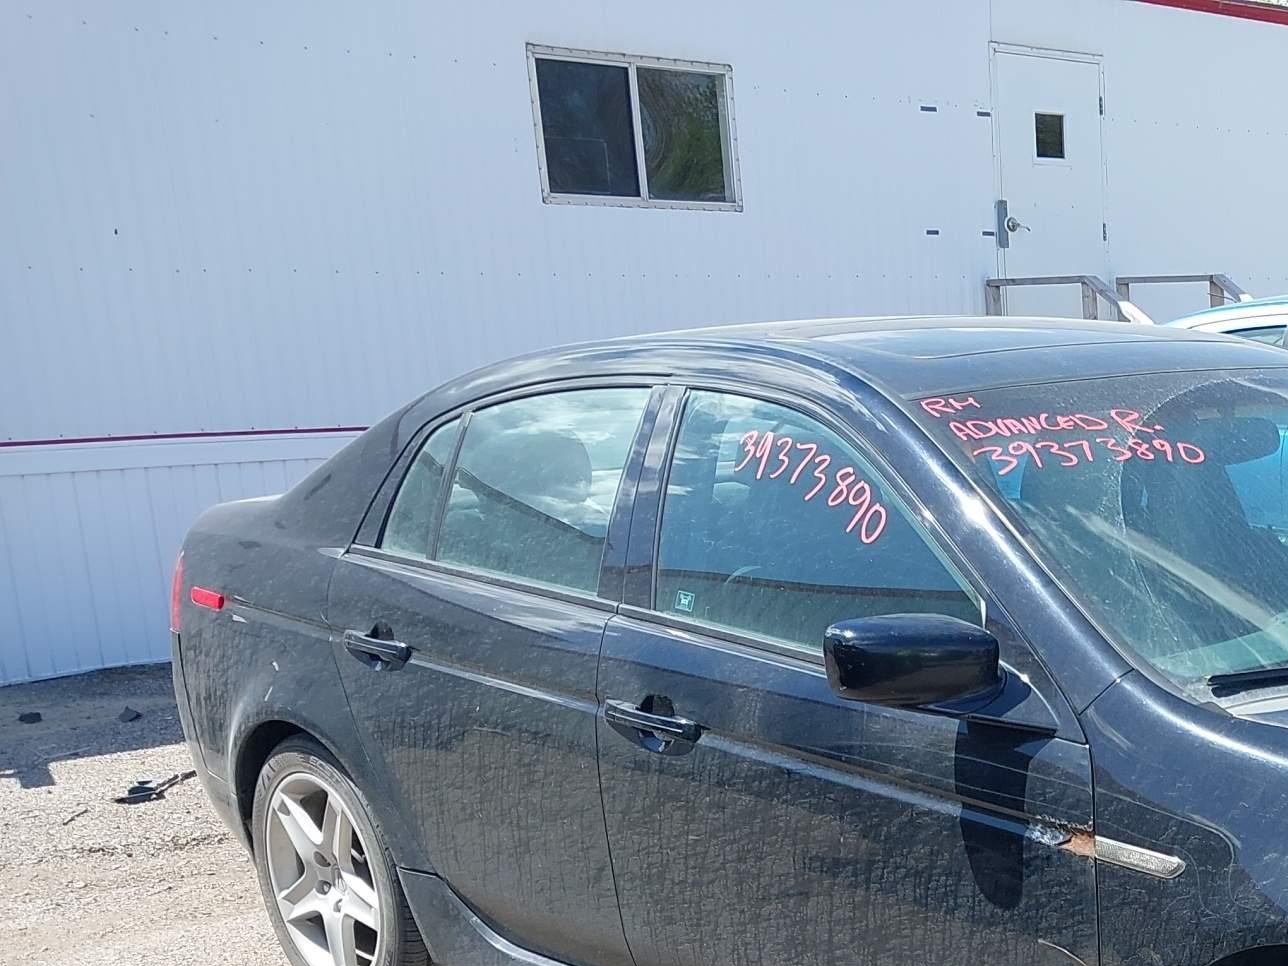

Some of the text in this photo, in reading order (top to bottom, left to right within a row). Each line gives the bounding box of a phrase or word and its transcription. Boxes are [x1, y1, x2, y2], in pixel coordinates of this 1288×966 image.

[948, 412, 1108, 442] ADVANCED
[972, 438, 1206, 476] 39373890
[734, 429, 887, 545] 39373890
